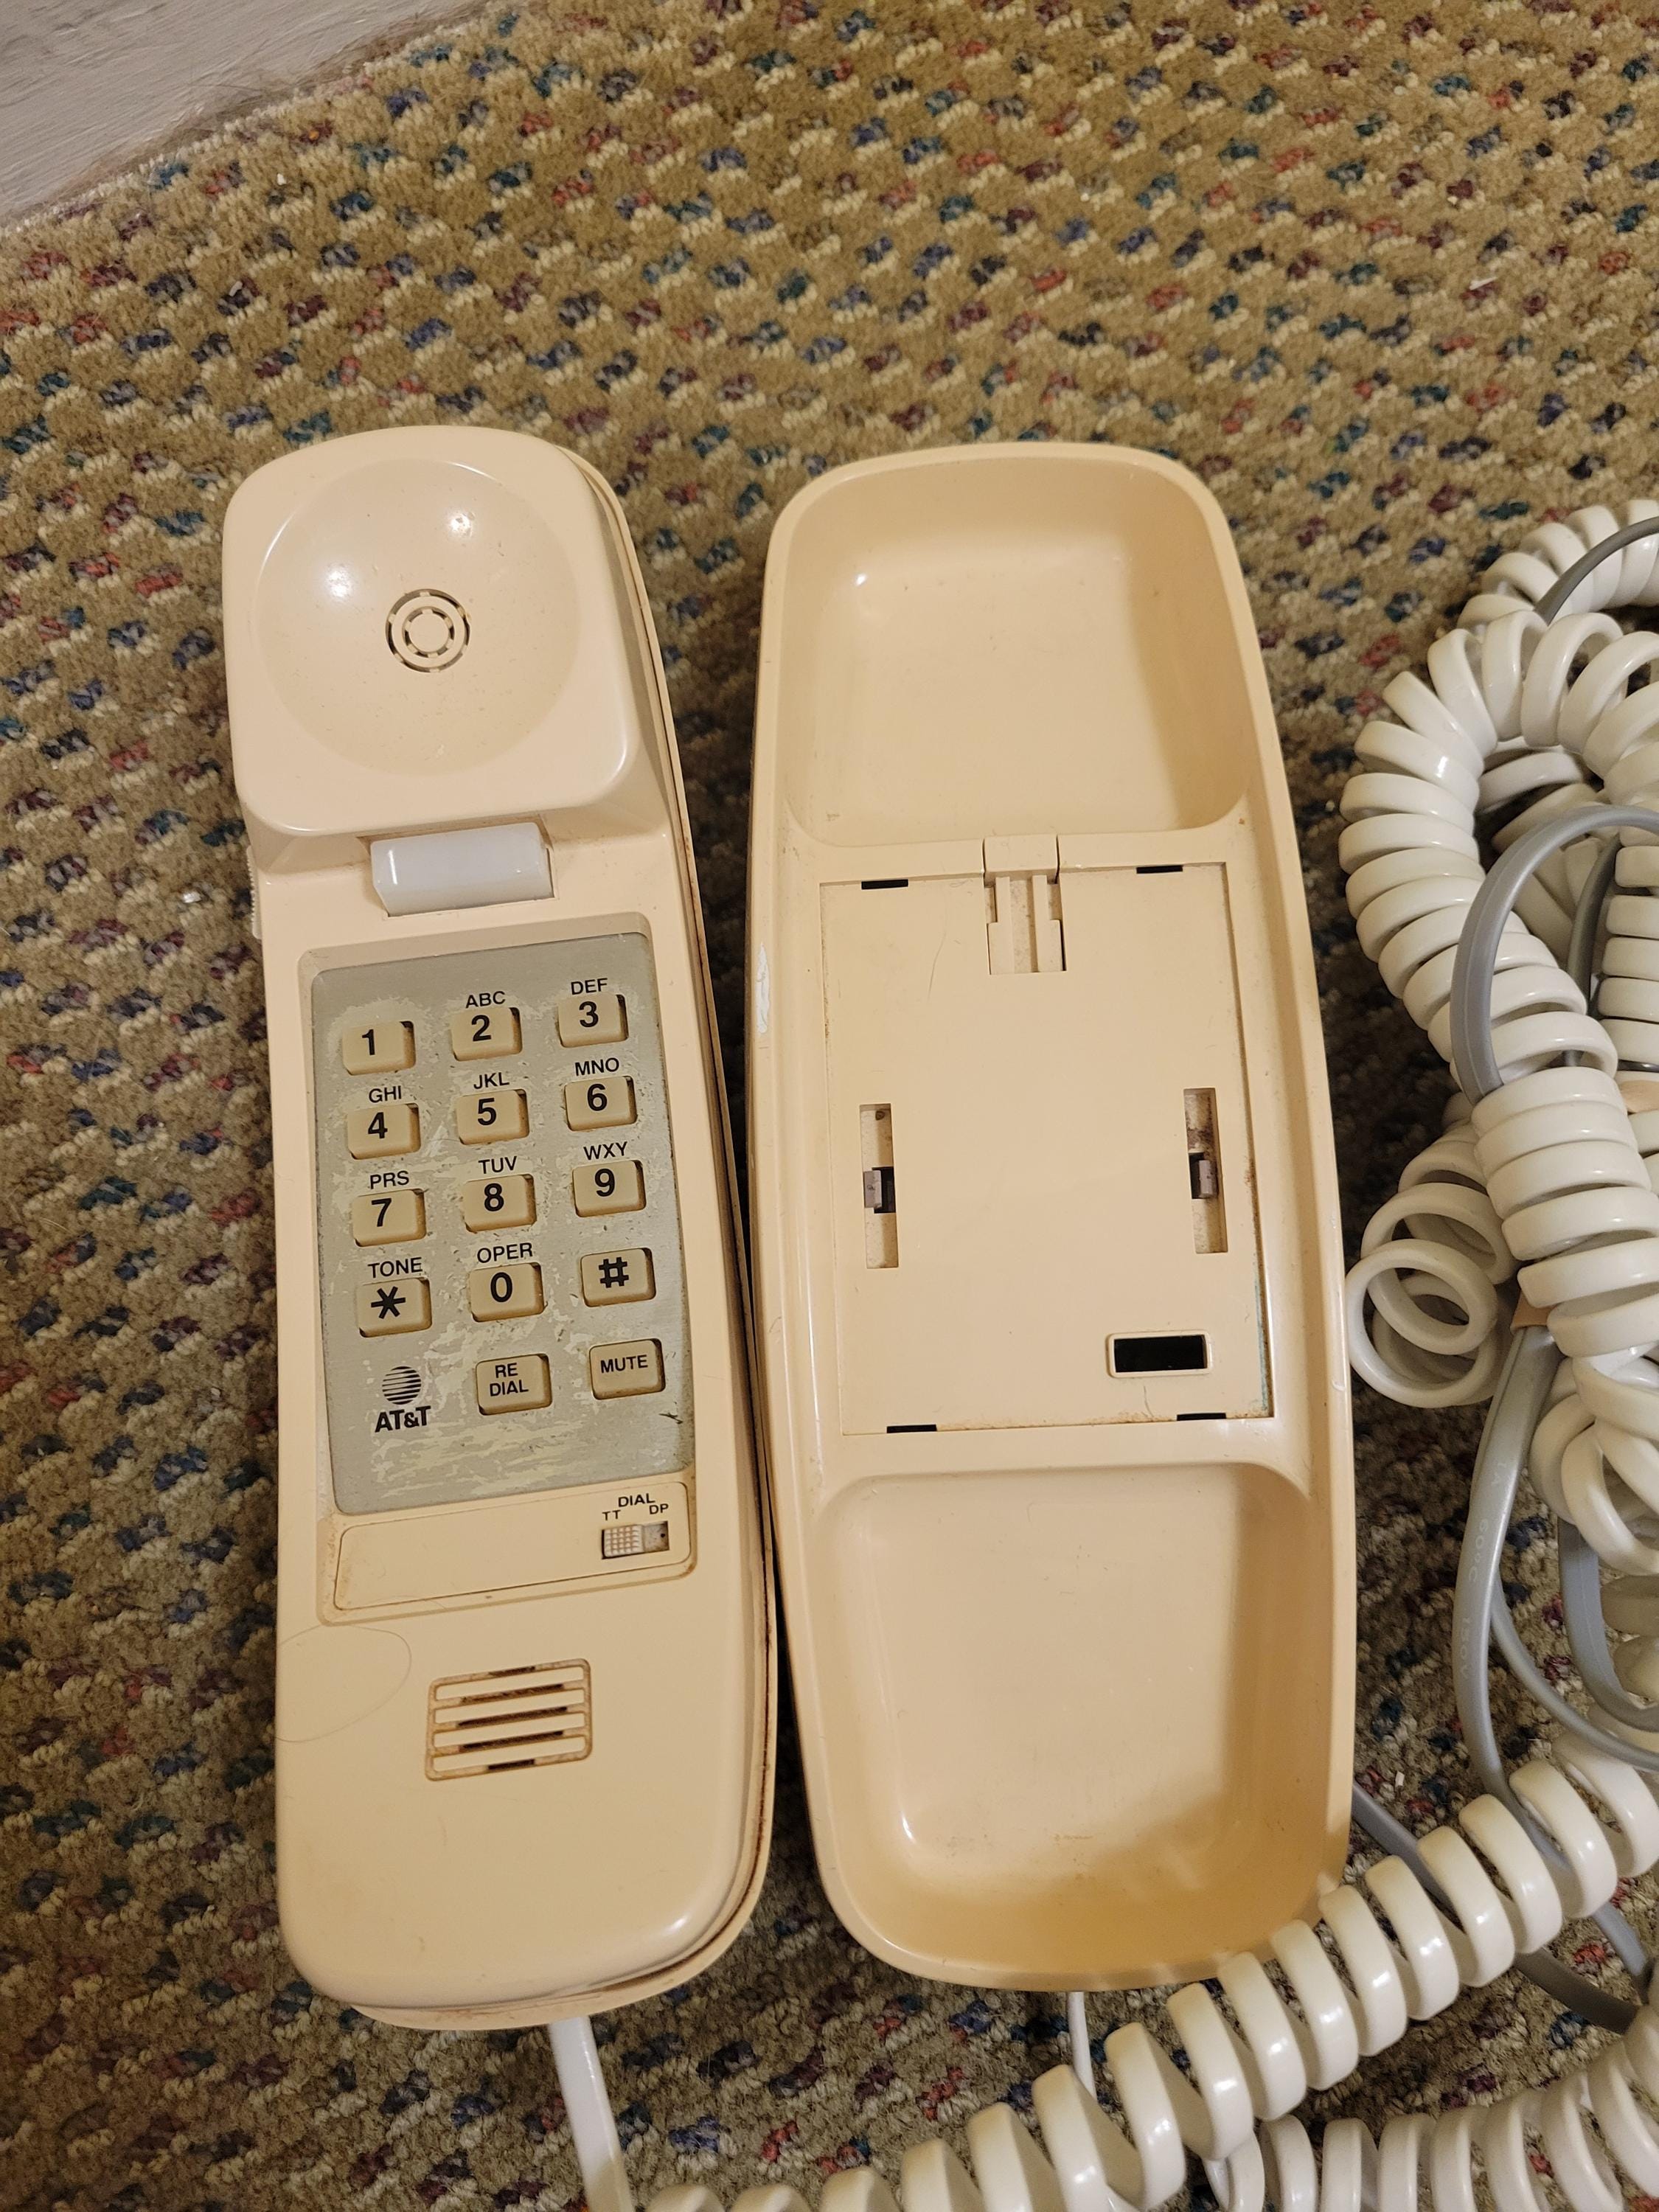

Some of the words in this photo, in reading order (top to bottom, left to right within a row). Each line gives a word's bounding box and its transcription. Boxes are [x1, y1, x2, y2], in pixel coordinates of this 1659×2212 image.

[571, 977, 608, 995] DEF
[465, 990, 506, 1009] ABC
[579, 1001, 599, 1028] 3
[471, 1015, 492, 1042] 2
[361, 1029, 375, 1056] 1
[574, 1057, 619, 1077] MNO
[473, 1071, 510, 1090] JKL
[369, 1085, 402, 1103] GHI
[587, 1083, 608, 1112] 6
[477, 1097, 497, 1126] 5
[367, 1111, 388, 1139] 4
[582, 1141, 627, 1161] WXY
[478, 1155, 518, 1175] TUV
[369, 1170, 409, 1190] PRS
[594, 1168, 616, 1197] 9
[484, 1183, 504, 1212] 8
[371, 1197, 392, 1228] 7
[476, 1242, 534, 1264] OPER
[369, 1256, 423, 1279] TONE
[598, 1256, 630, 1289] #
[490, 1272, 513, 1303] 0
[495, 1362, 518, 1379] RE
[600, 1354, 648, 1374] MUTE
[489, 1379, 529, 1397] DIAL
[375, 1405, 431, 1433] AT&T
[618, 1493, 655, 1508] DIAL
[649, 1503, 669, 1515] DP
[602, 1509, 621, 1521] TT
